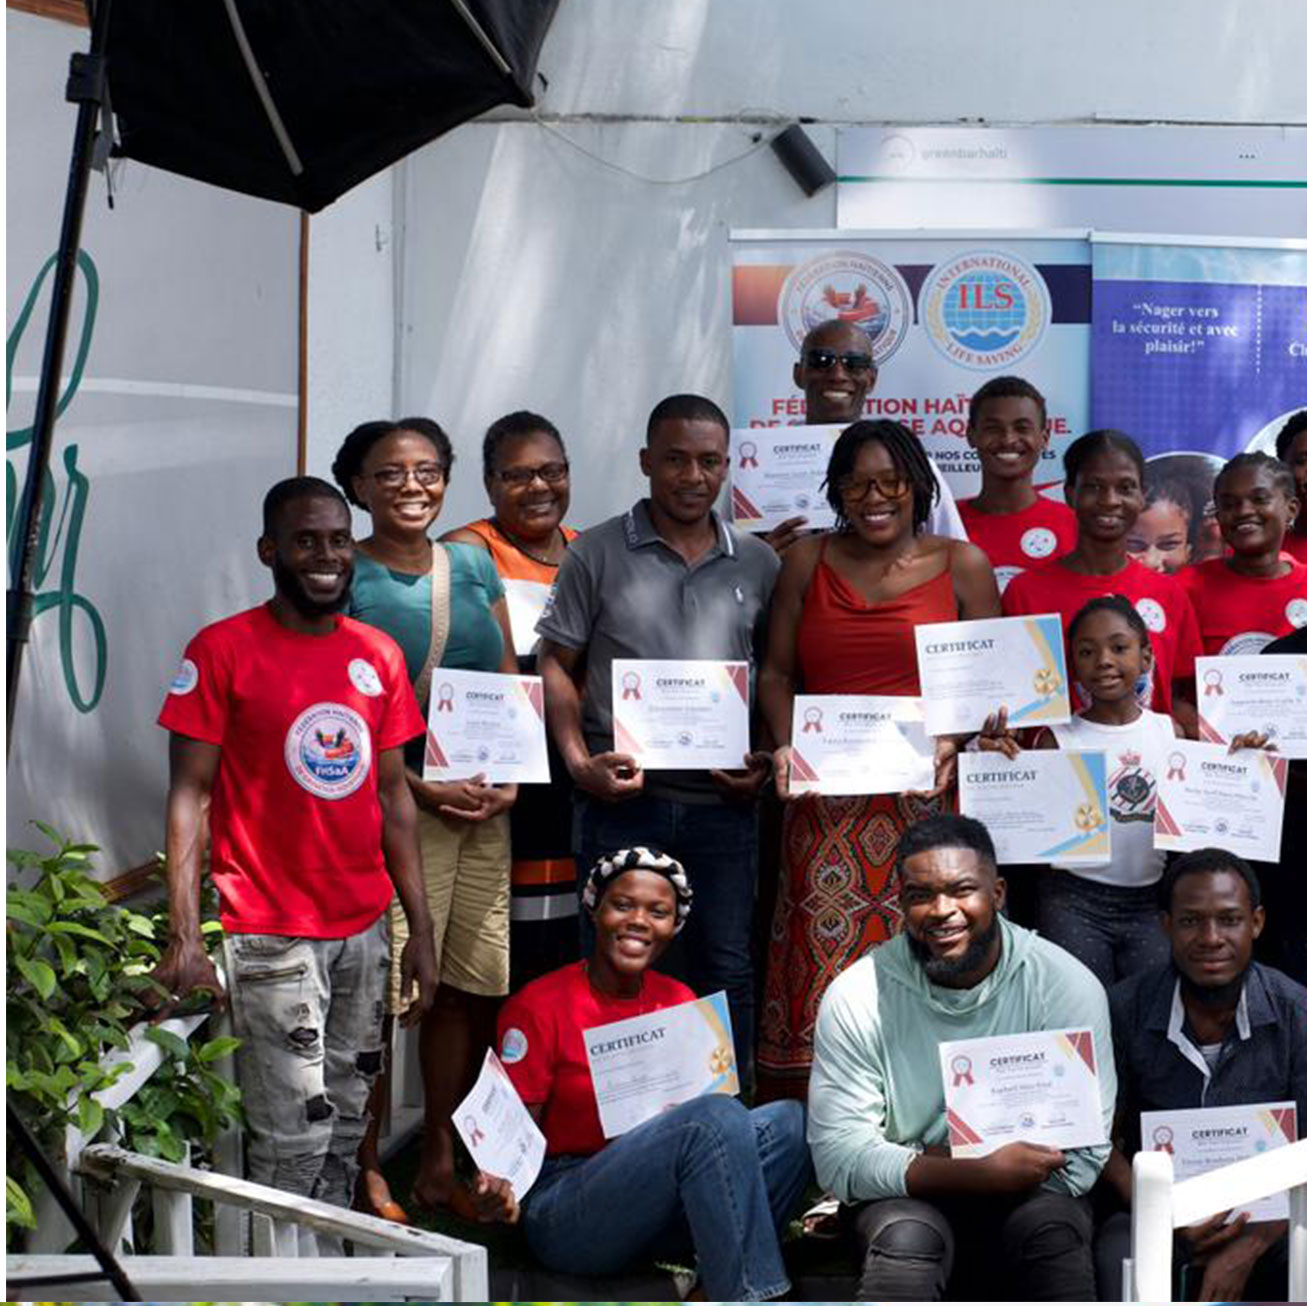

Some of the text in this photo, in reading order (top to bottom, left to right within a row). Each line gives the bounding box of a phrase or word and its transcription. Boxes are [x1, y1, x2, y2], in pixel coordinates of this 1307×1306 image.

[937, 254, 1031, 290] INTERNATIONAL
[958, 282, 1014, 309] ILS
[1189, 306, 1218, 318] vers
[1112, 320, 1238, 338] la sécurité et avec
[925, 639, 995, 655] CERTIFICAT
[966, 770, 1038, 784] CERTIFICAT
[589, 1027, 667, 1056] CERTIFICAT
[1191, 1126, 1248, 1139] CERTIFICAT
